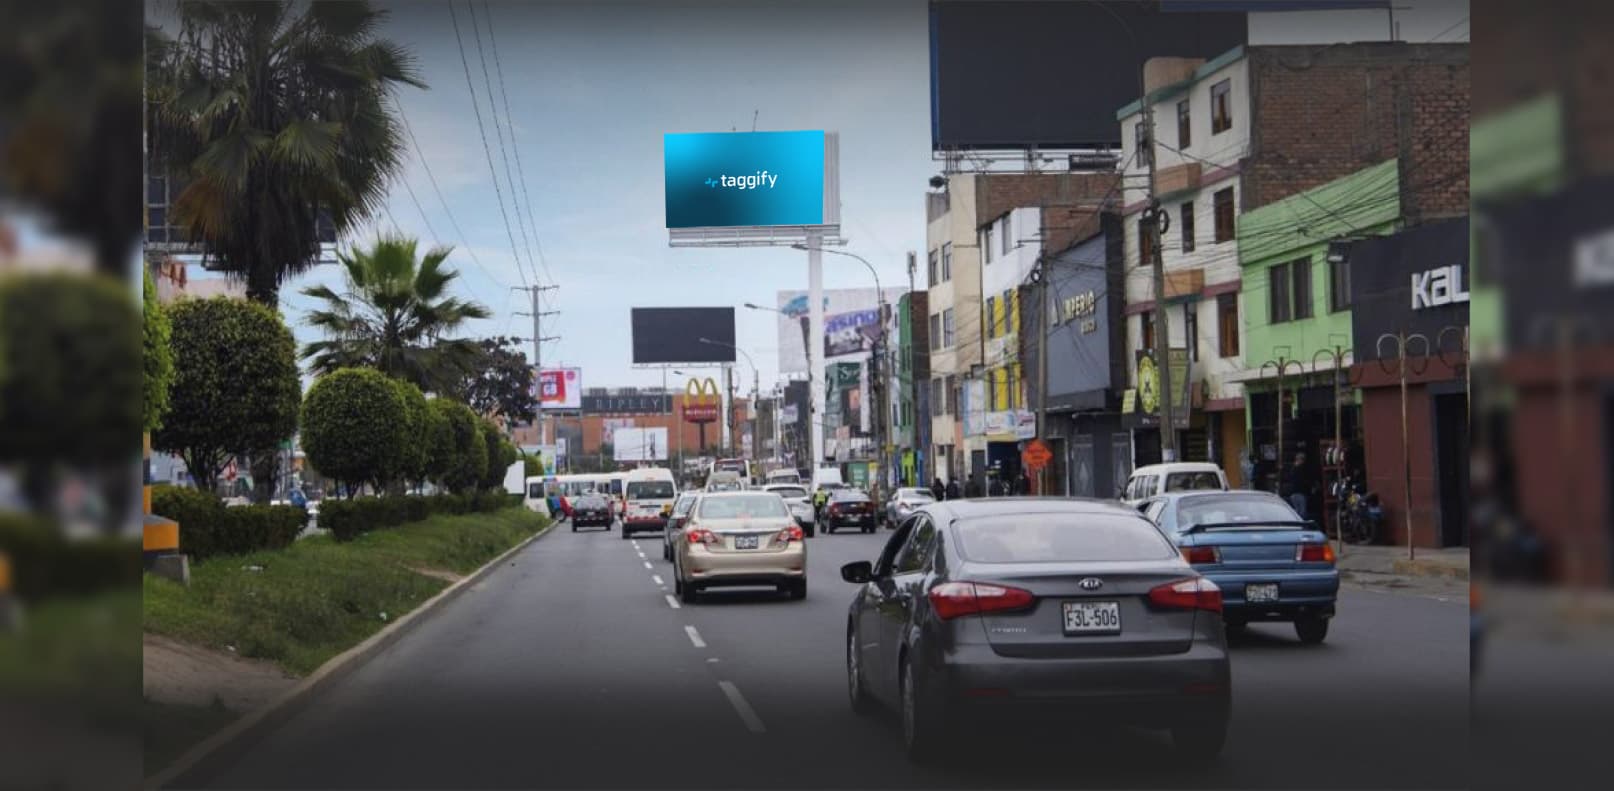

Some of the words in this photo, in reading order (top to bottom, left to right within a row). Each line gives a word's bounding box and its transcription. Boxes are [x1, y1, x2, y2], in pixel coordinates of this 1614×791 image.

[720, 170, 778, 190] taggify
[823, 309, 880, 333] asino
[1066, 609, 1118, 628] F3L-506
